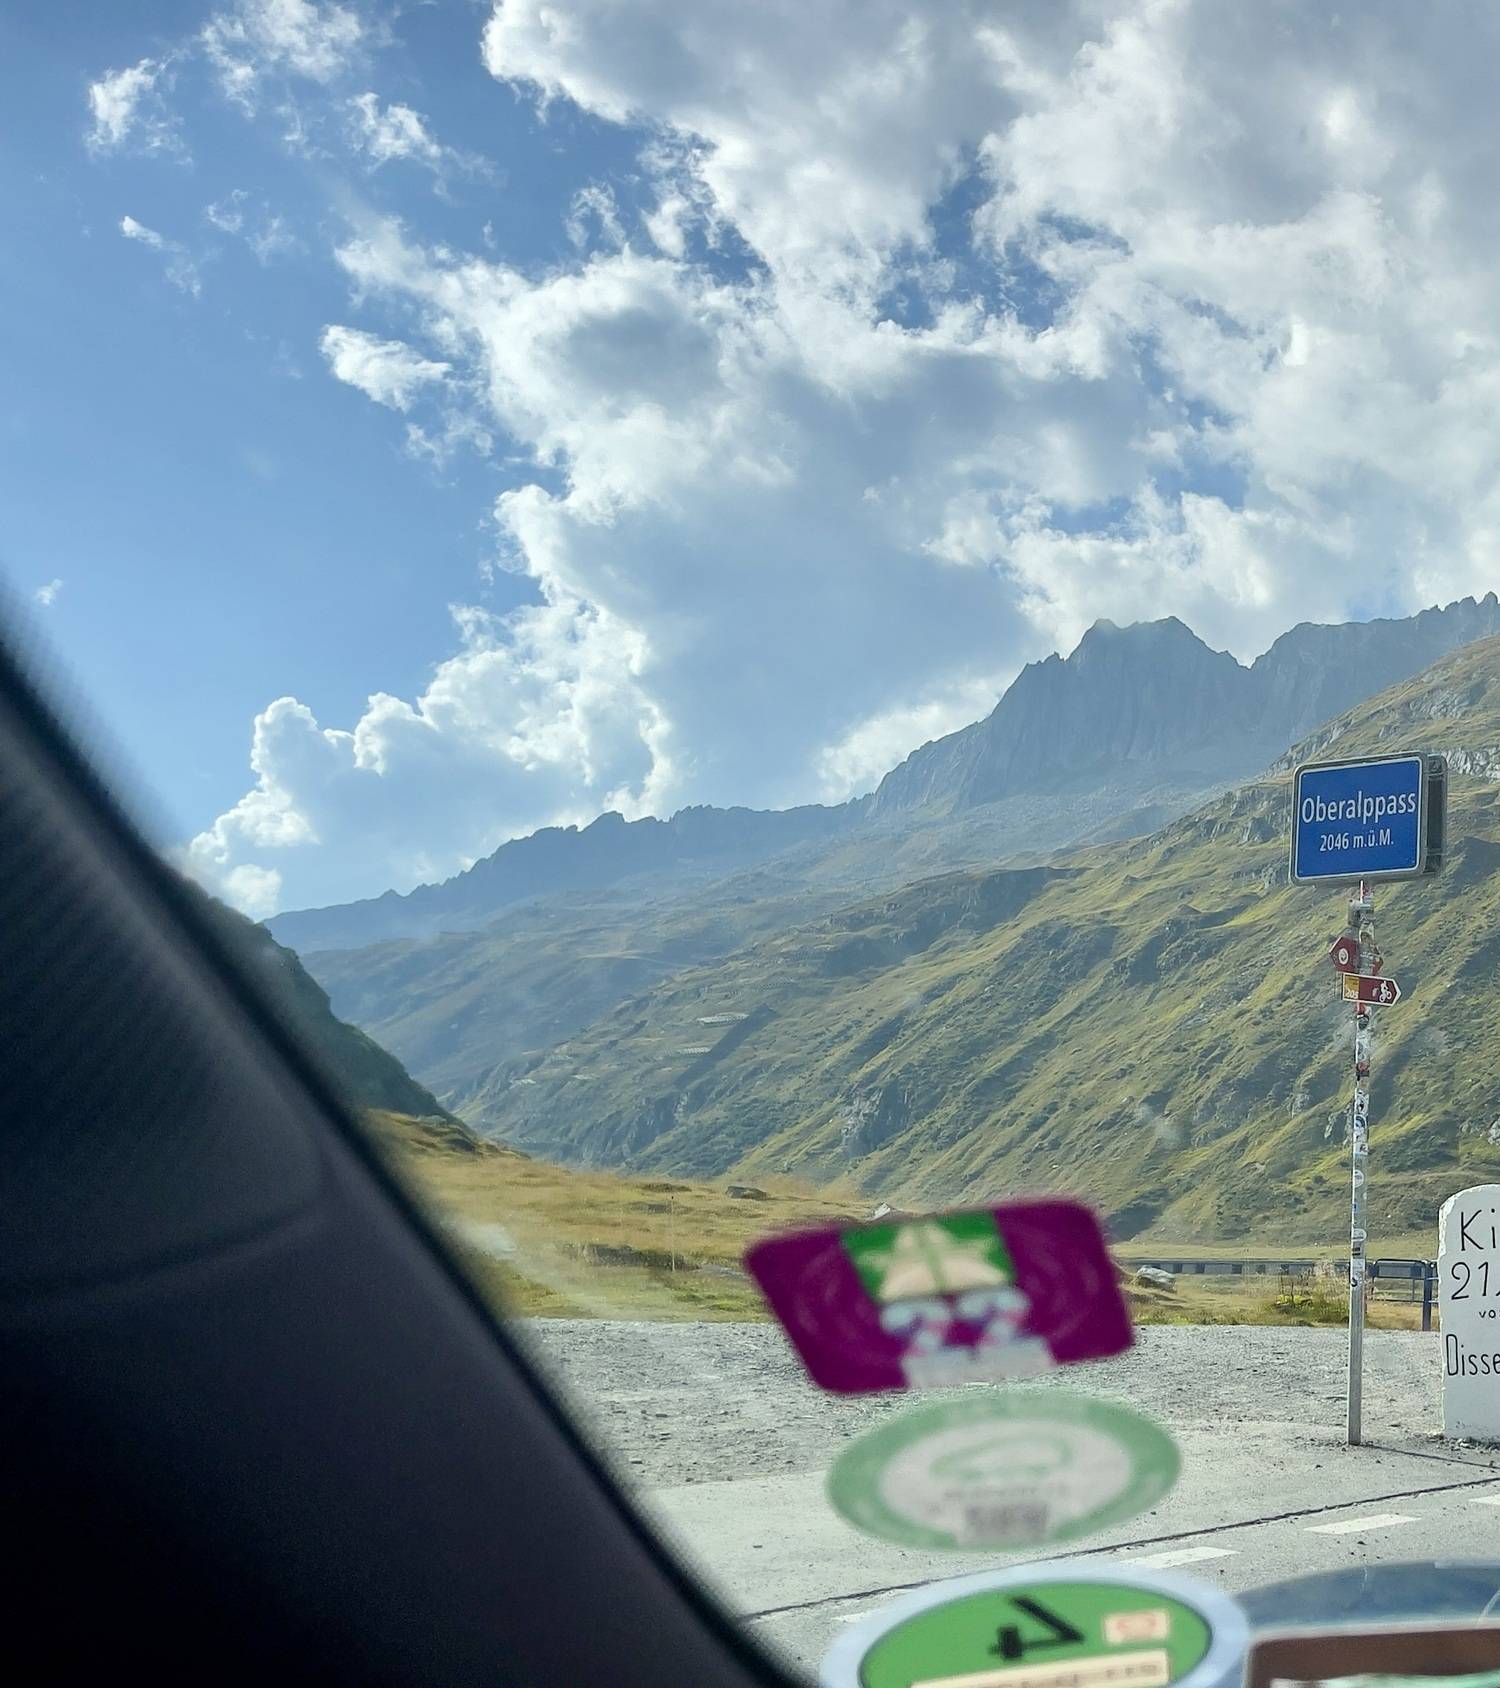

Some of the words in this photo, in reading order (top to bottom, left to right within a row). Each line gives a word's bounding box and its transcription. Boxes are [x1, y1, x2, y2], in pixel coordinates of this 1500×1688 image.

[1301, 790, 1417, 825] Oberalppass
[1319, 832, 1350, 853] 2046
[1353, 828, 1395, 849] m.ü.M.
